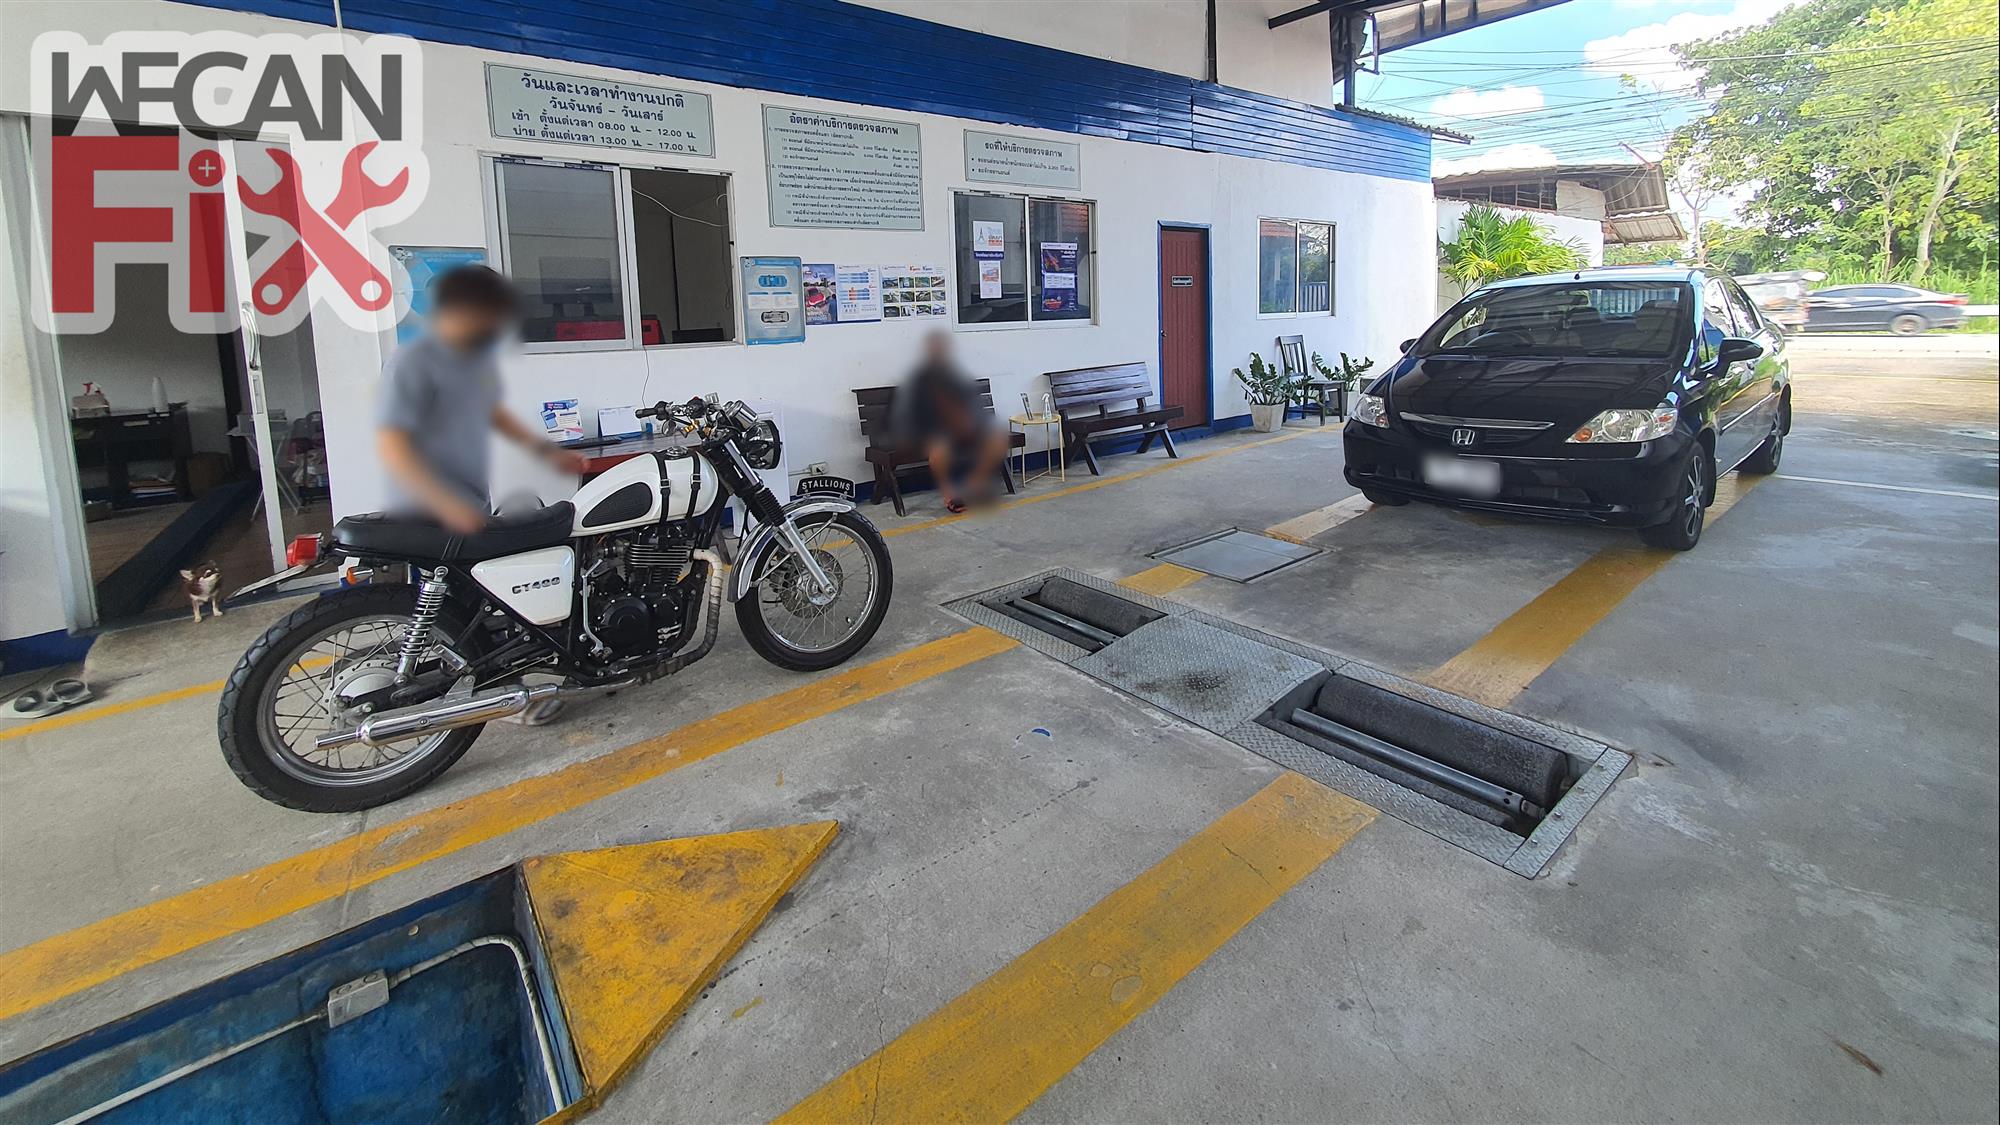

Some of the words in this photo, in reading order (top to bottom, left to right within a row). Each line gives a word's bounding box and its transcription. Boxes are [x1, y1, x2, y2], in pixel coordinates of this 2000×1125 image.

[521, 72, 684, 107] วันและเวลาทำงานปกติ
[549, 96, 603, 114] วันจันทร์
[621, 105, 664, 121] วันเสาร์
[511, 108, 530, 121] เช้า
[540, 108, 594, 128] ตั้งแต่เวลา
[597, 121, 626, 132] 08.00
[657, 128, 682, 137] 12.00
[789, 112, 899, 135] อัตราค่าบริการตรวจสภาพ
[512, 124, 536, 137] บ่าย
[540, 124, 595, 142] ตั้งแต่เวลา
[600, 136, 627, 145] 13.00
[659, 142, 683, 151] 17.00
[802, 480, 850, 490] STALLIONS
